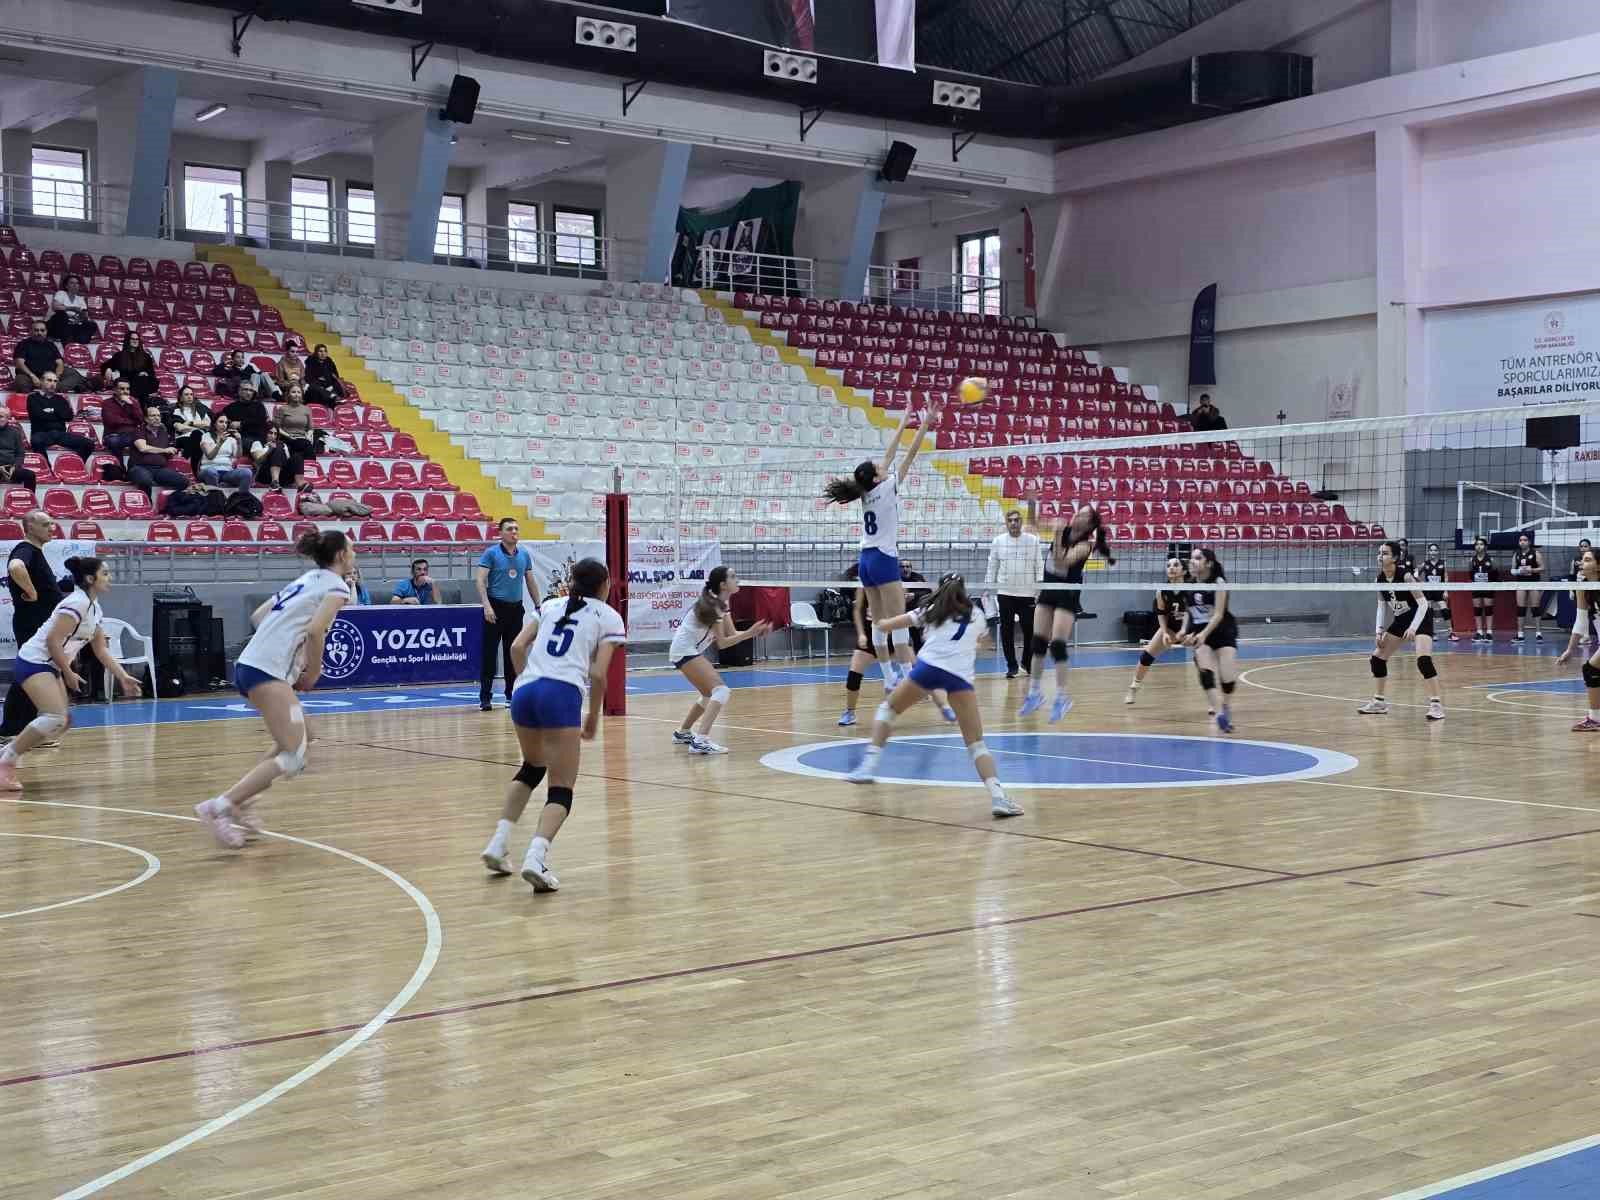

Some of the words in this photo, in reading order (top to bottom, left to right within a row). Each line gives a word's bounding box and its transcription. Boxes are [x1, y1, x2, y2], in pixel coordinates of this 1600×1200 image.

[1529, 351, 1593, 368] ANTRENÖR
[1503, 366, 1600, 384] SPORCULARIMIZ
[1497, 385, 1553, 399] BAŞARILAR
[863, 510, 878, 536] 8
[646, 545, 675, 553] YOZGA
[371, 627, 467, 650] YOZGAT
[546, 618, 579, 657] 5
[371, 655, 397, 664] Gençlik
[408, 654, 424, 664] Spor
